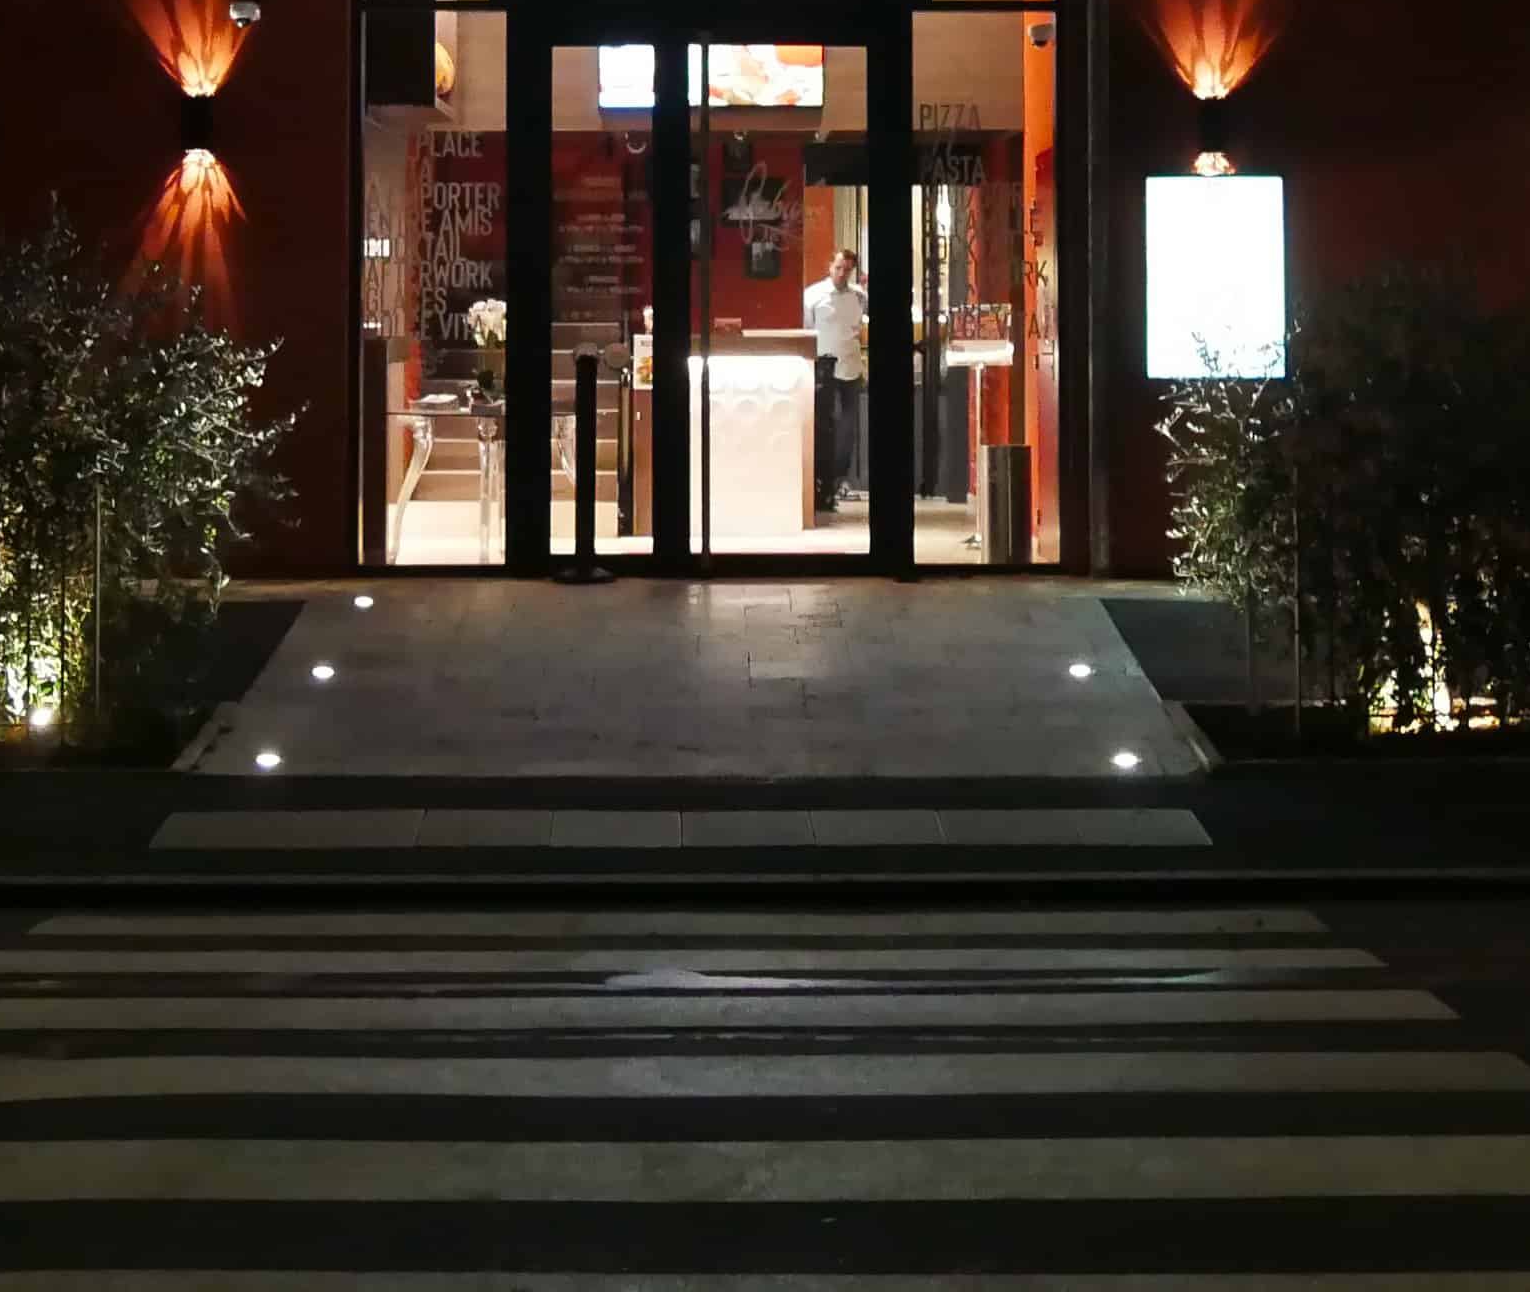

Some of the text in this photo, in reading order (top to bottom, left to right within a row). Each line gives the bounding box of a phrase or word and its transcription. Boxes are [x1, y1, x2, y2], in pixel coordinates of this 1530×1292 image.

[919, 104, 981, 131] PIZZA
[417, 131, 485, 158] PLACE
[392, 182, 502, 210] PORTER
[439, 209, 494, 236] AMIS
